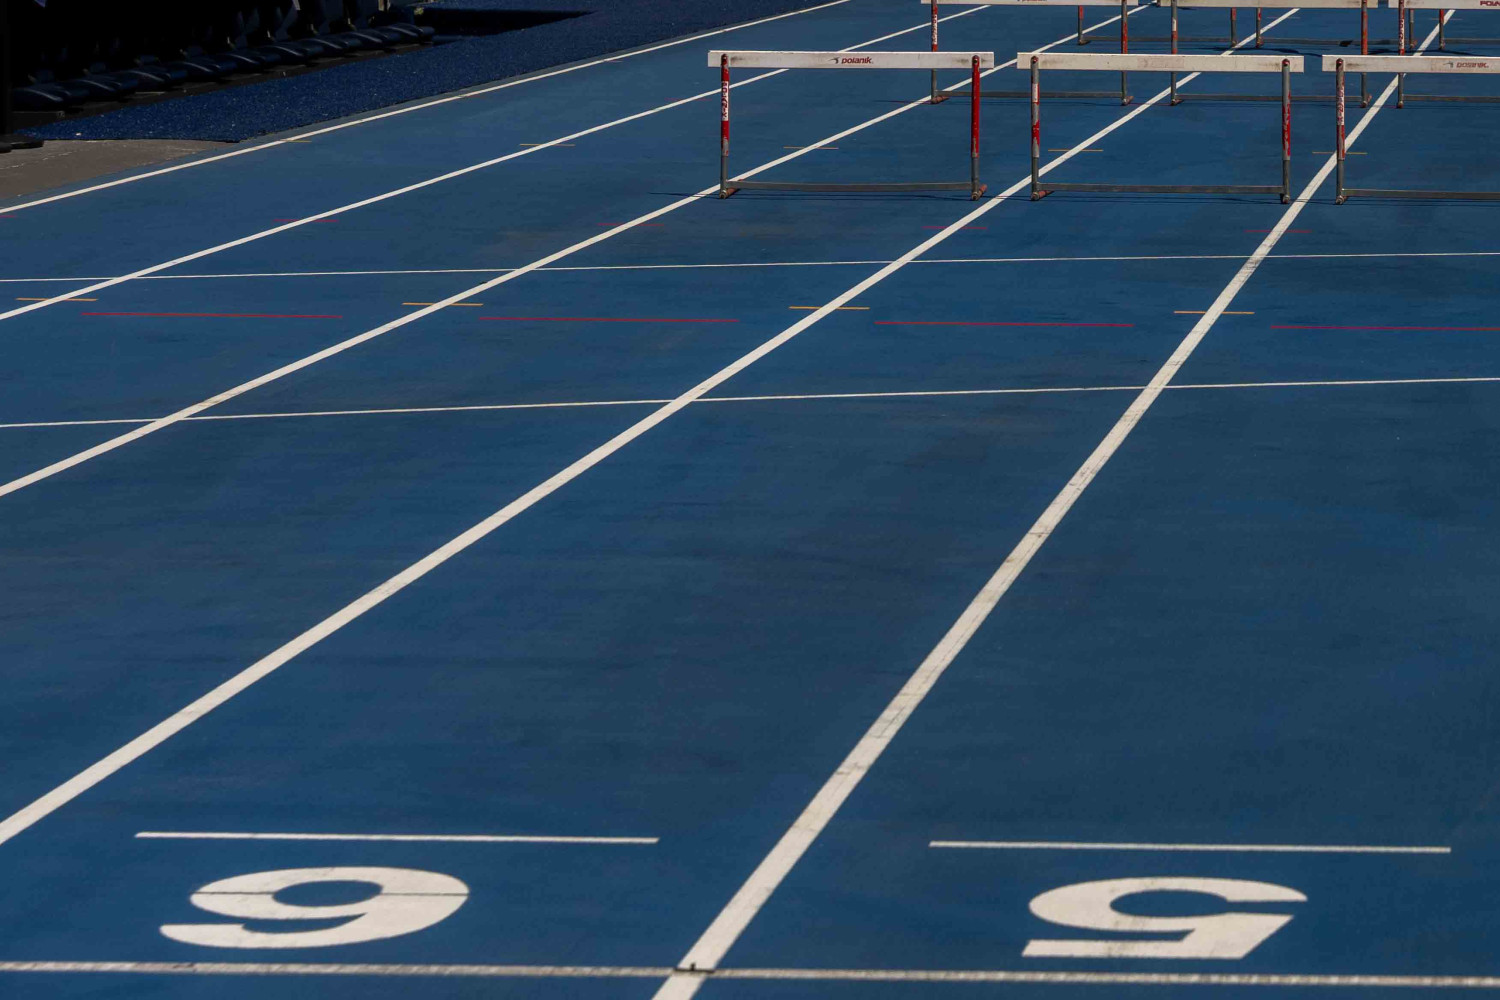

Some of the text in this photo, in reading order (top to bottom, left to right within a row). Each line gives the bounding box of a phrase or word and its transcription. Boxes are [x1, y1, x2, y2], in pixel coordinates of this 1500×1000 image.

[841, 56, 872, 64] polanik
[158, 865, 470, 949] 6
[1022, 876, 1307, 960] 5
